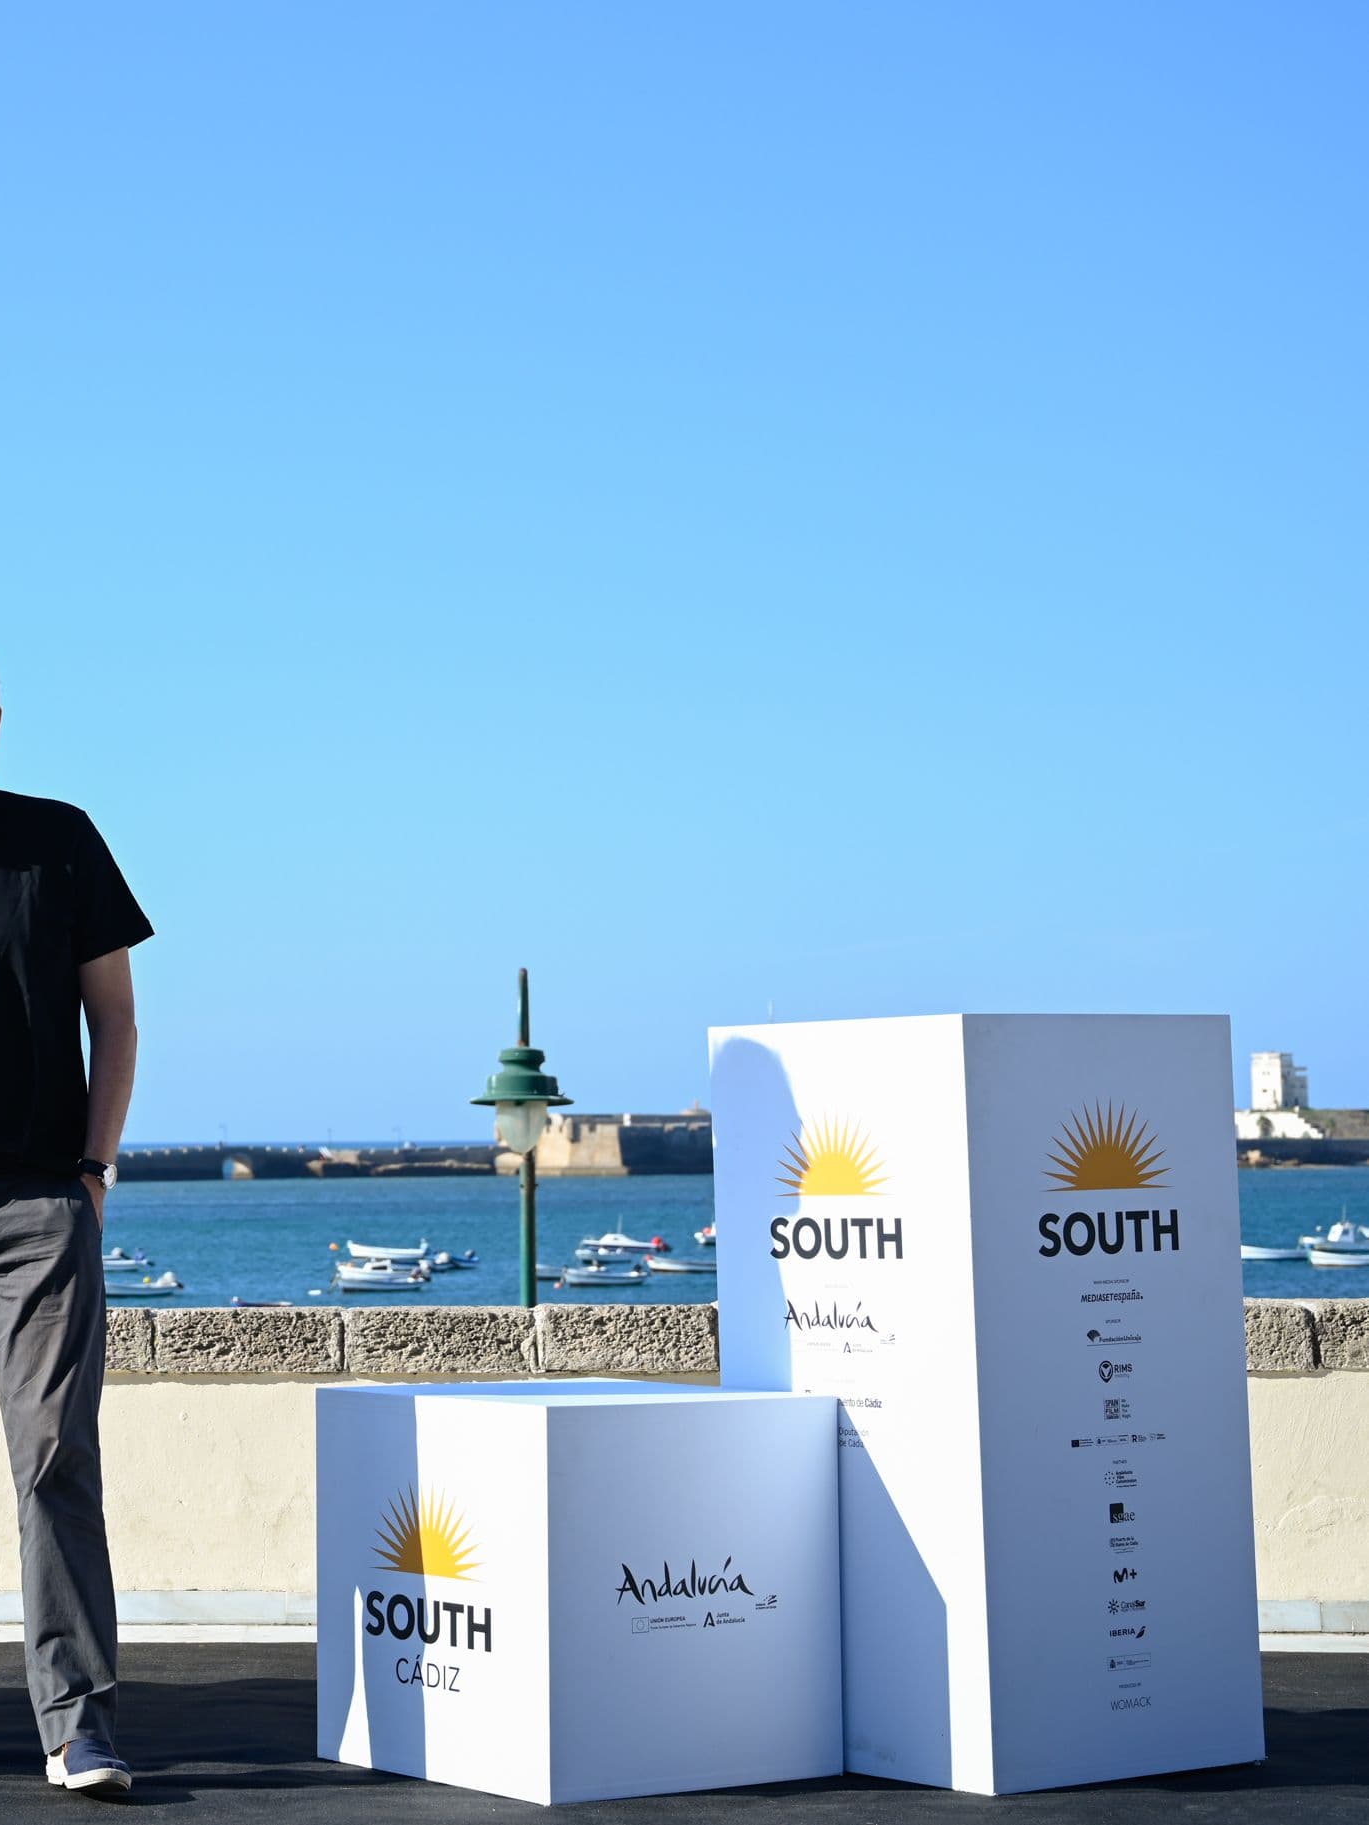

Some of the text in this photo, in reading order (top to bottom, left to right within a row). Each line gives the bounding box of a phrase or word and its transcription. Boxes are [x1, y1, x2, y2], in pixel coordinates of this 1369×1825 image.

[770, 1217, 904, 1260] SOUTH
[1038, 1209, 1180, 1258] SOUTH
[783, 1299, 879, 1333] Andalucía
[1114, 1363, 1132, 1373] RIMS
[865, 1398, 882, 1408] Cádiz
[1113, 1511, 1135, 1524] sgae
[615, 1556, 755, 1606] Andalucía
[365, 1590, 492, 1652] SOUTH
[1109, 1628, 1136, 1637] IBERIA
[395, 1654, 461, 1693] CÁDIZ
[1110, 1696, 1151, 1711] WOMACK
